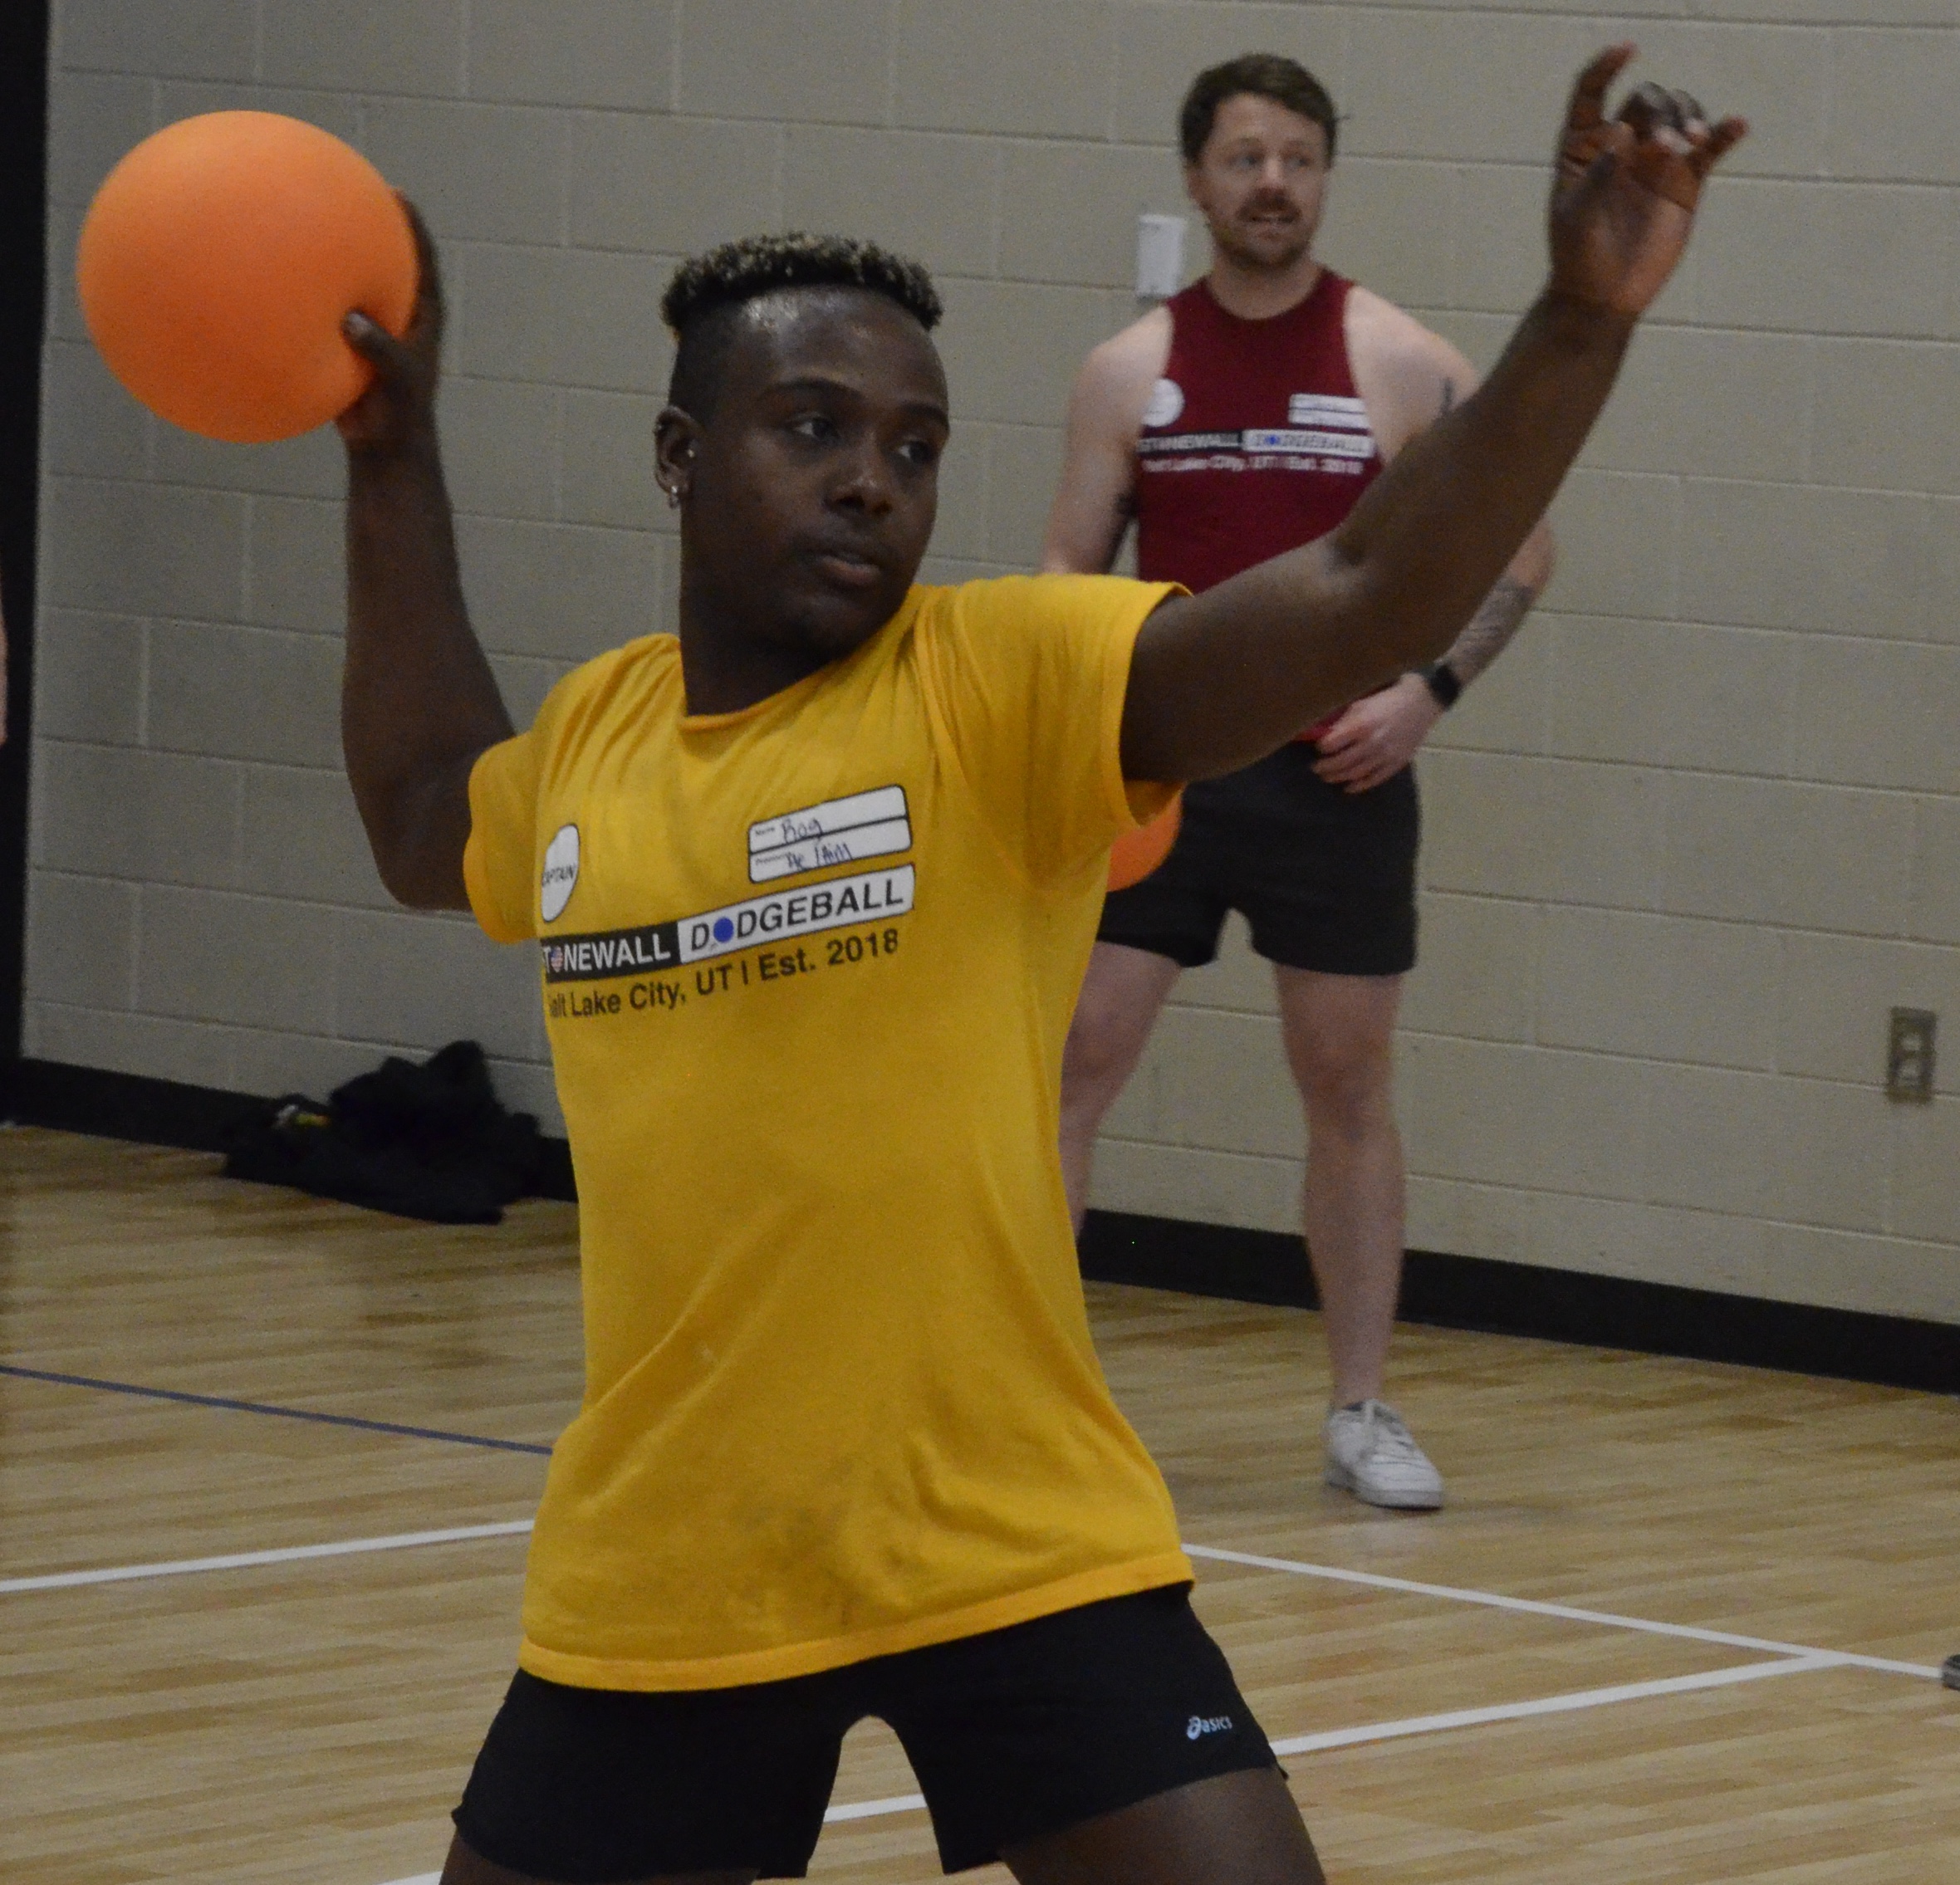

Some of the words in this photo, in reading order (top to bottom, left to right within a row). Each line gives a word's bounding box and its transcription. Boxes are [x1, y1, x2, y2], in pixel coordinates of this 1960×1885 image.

[542, 933, 671, 973] TONEWALL
[571, 990, 621, 1018] Lake
[696, 962, 733, 996] UT
[758, 947, 816, 982] Est.
[826, 928, 899, 967] 2018
